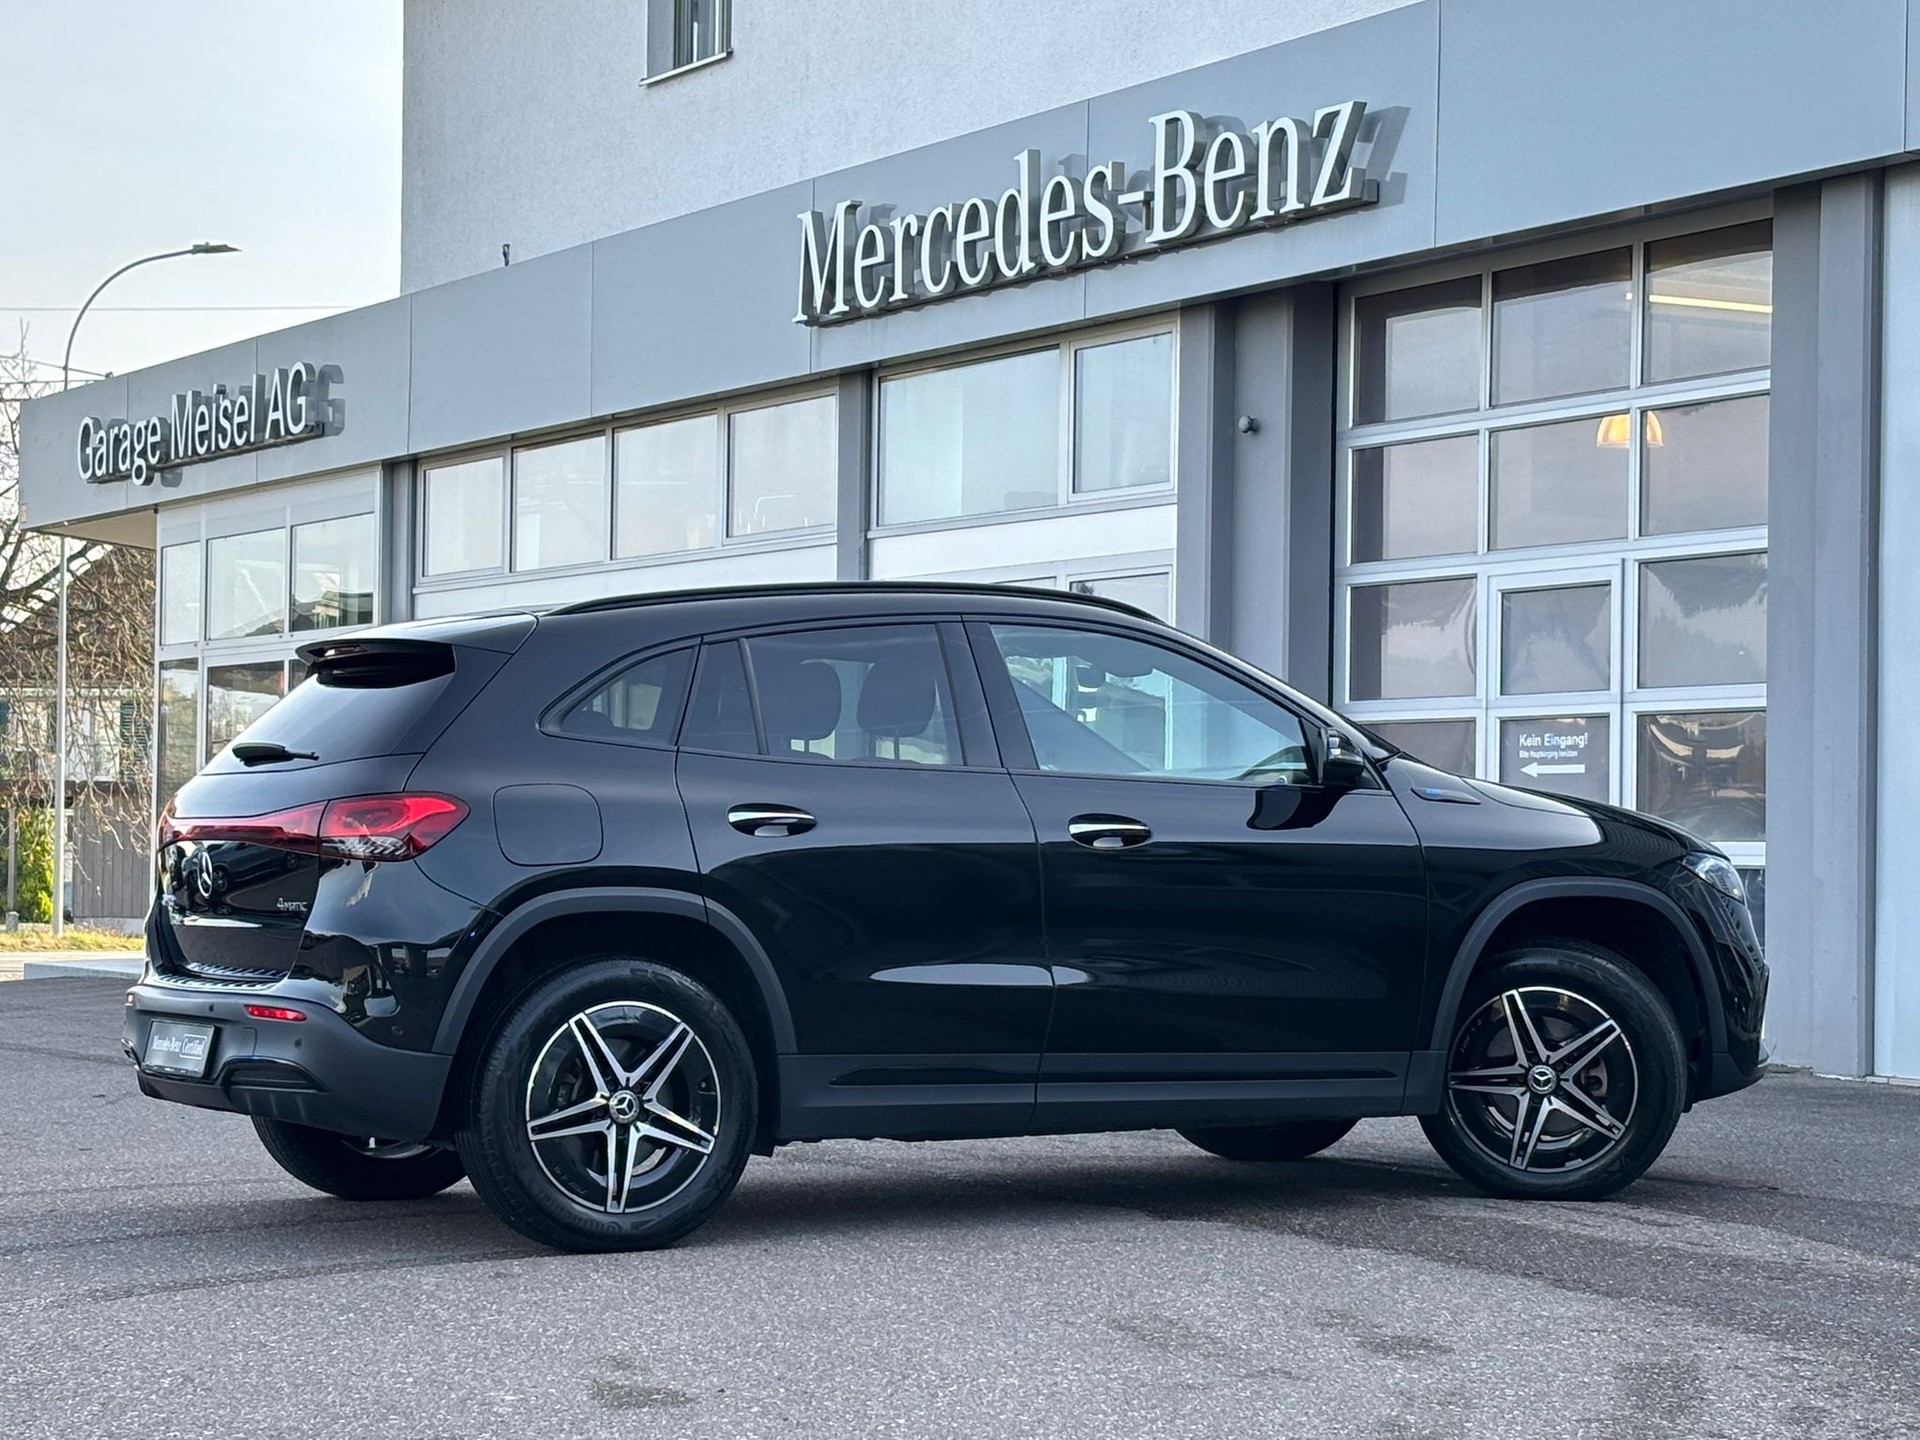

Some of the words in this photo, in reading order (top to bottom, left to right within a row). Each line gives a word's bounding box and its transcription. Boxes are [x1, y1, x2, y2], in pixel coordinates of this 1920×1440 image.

[793, 100, 1367, 324] Mercedes-Benz
[77, 416, 162, 486] Garage
[171, 374, 257, 460] Meisel
[265, 361, 307, 439] AG
[1519, 734, 1541, 747] Kein
[1544, 732, 1588, 748] Eingang!
